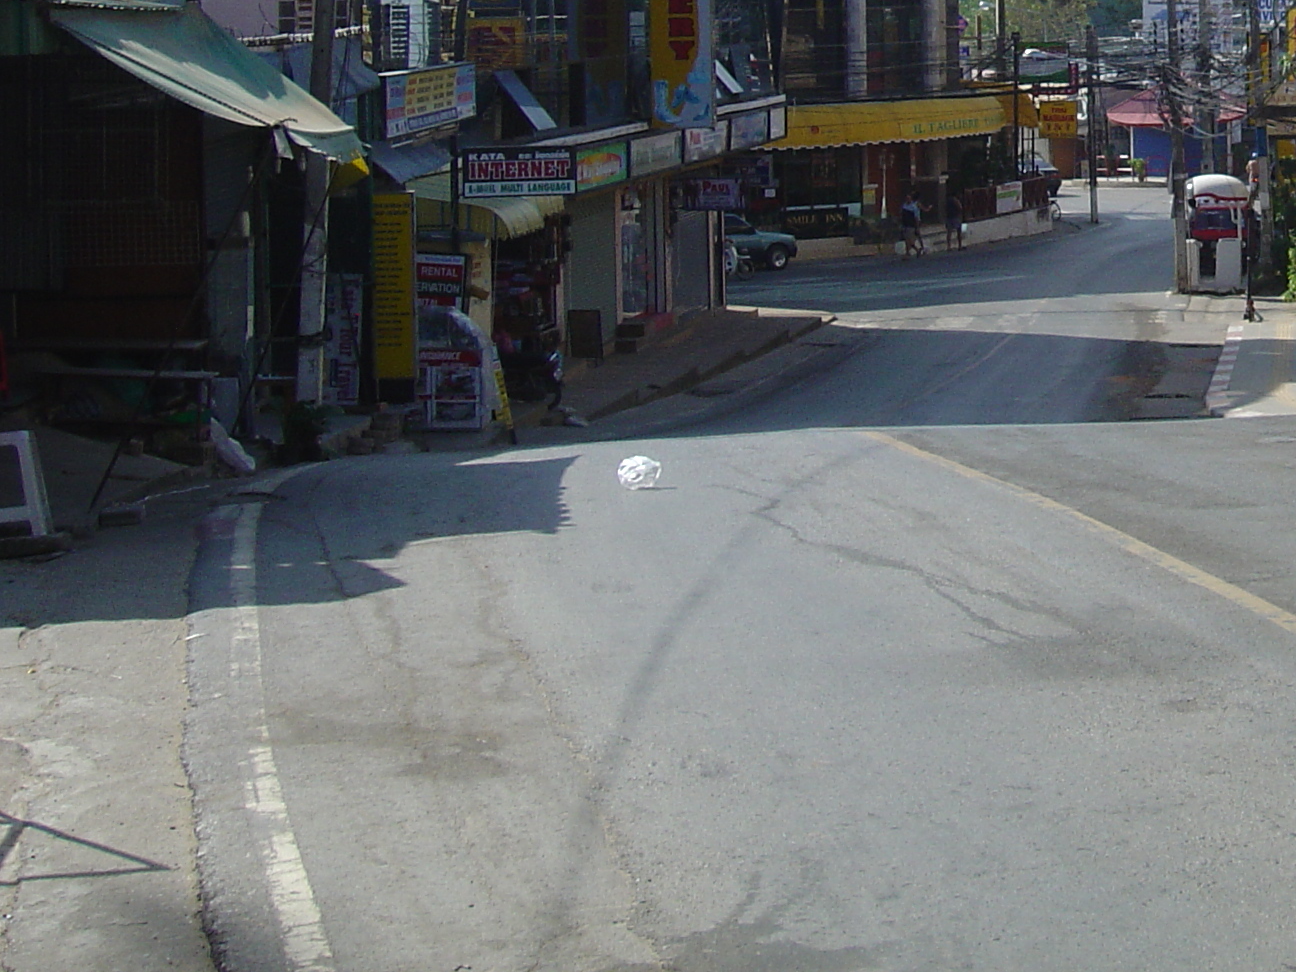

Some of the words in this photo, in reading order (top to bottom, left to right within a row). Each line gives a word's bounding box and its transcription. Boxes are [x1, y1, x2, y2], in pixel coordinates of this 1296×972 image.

[468, 152, 505, 161] KATA
[468, 158, 571, 180] INTERNET
[500, 183, 524, 193] MULTI
[528, 182, 571, 192] LANGUAGE
[421, 265, 459, 278] RENTAL
